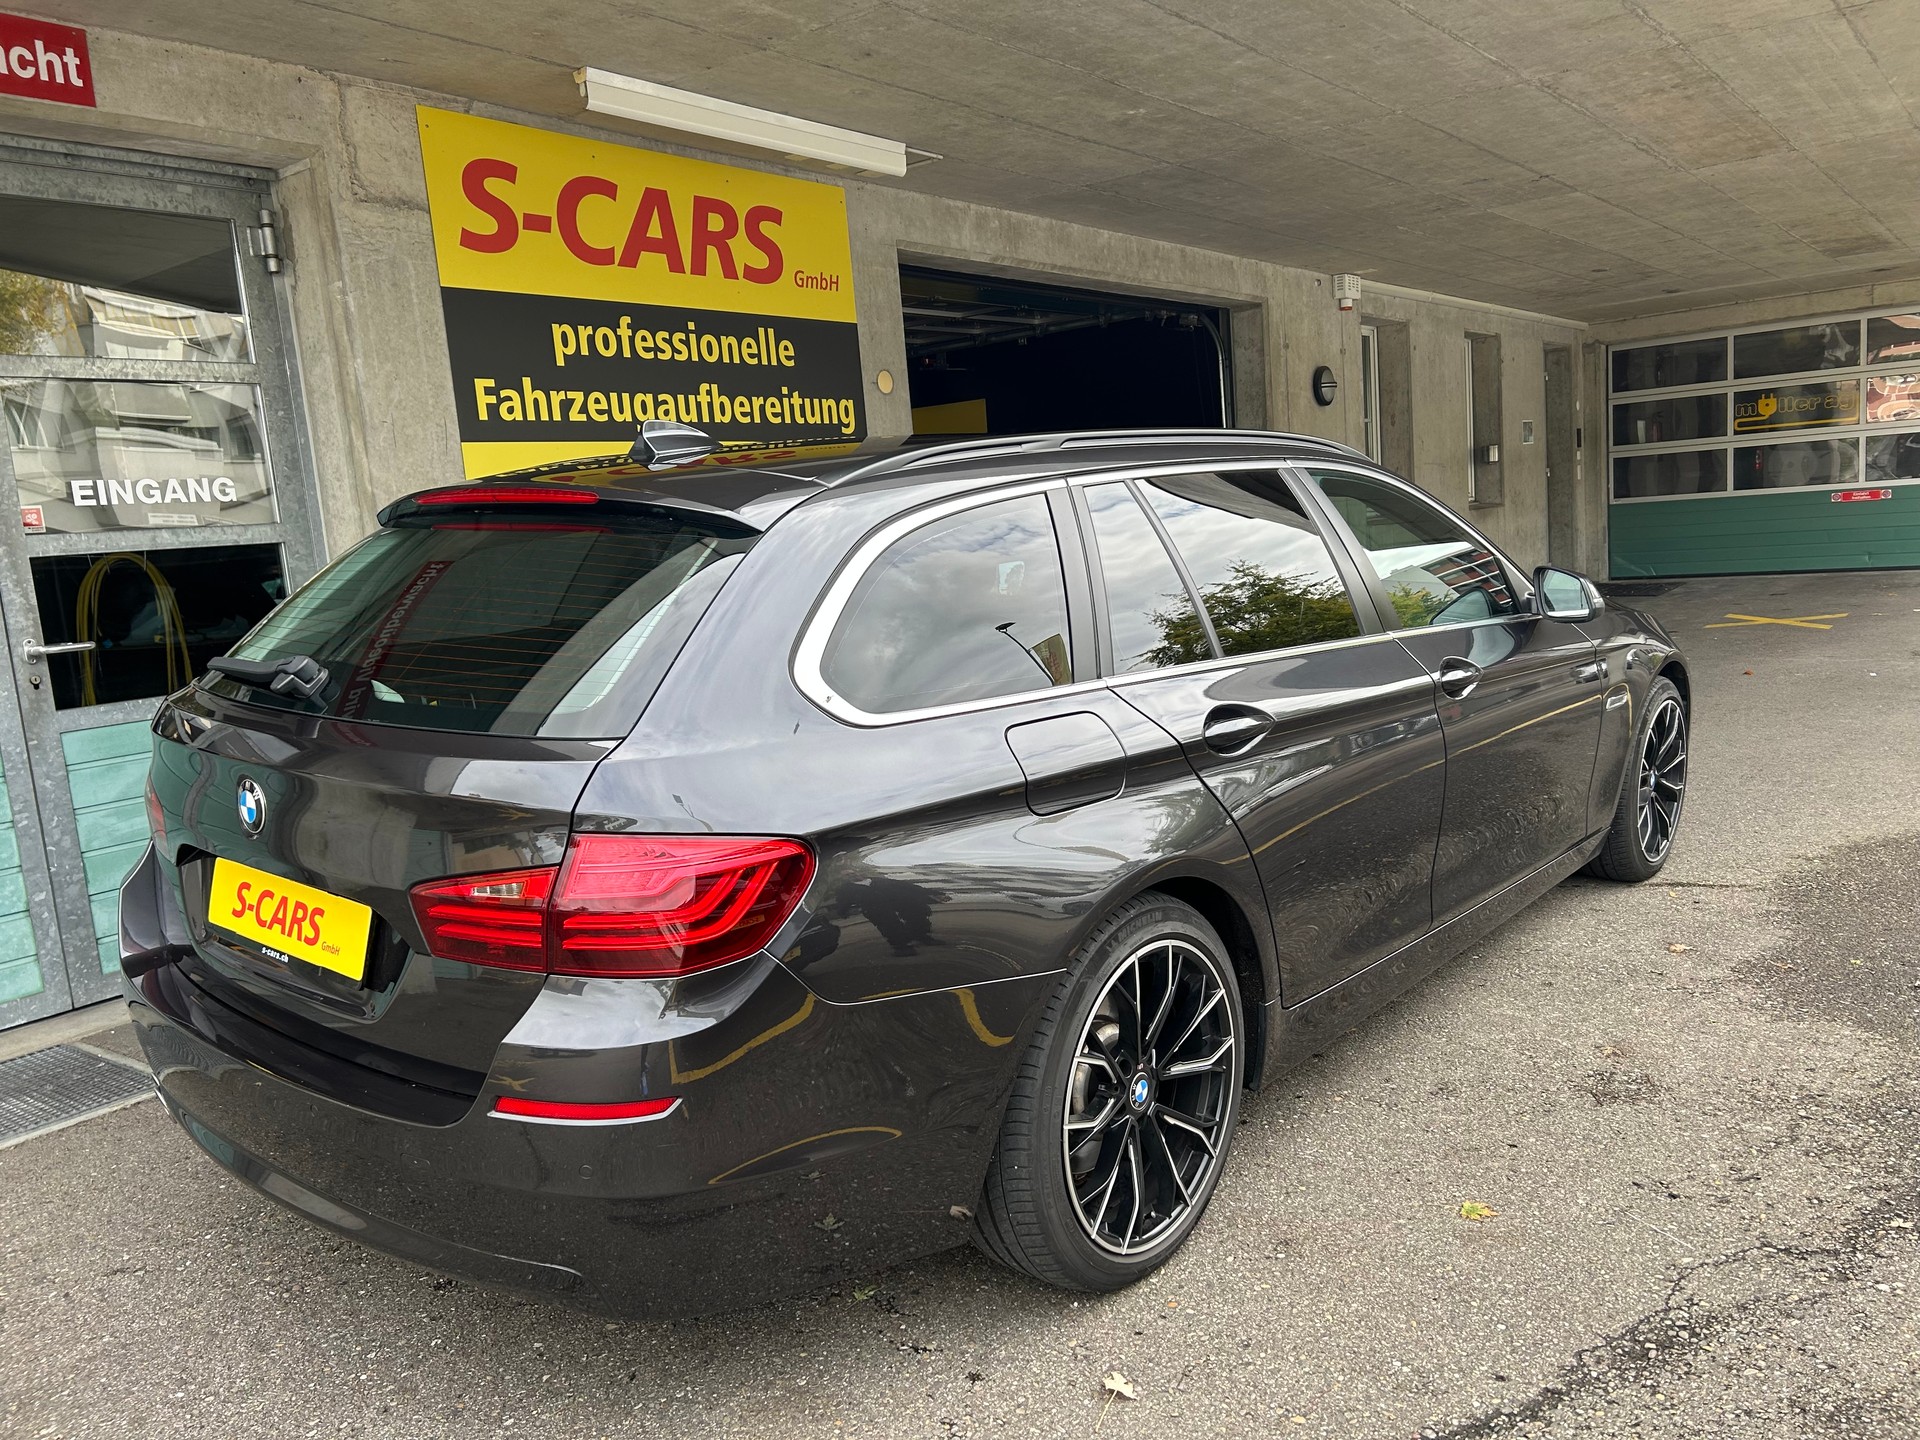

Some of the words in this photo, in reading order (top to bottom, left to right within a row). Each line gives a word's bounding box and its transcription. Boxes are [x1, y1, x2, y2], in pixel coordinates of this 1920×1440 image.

[459, 158, 785, 285] S-CARS
[793, 269, 840, 293] GmbH
[552, 315, 796, 367] professionelle
[473, 376, 856, 435] Fahrzeugaufbereitung
[71, 476, 237, 507] EINGANG
[231, 881, 325, 947] S-CARS
[321, 941, 341, 957] GmbH
[261, 945, 289, 964] s-cars.ch
